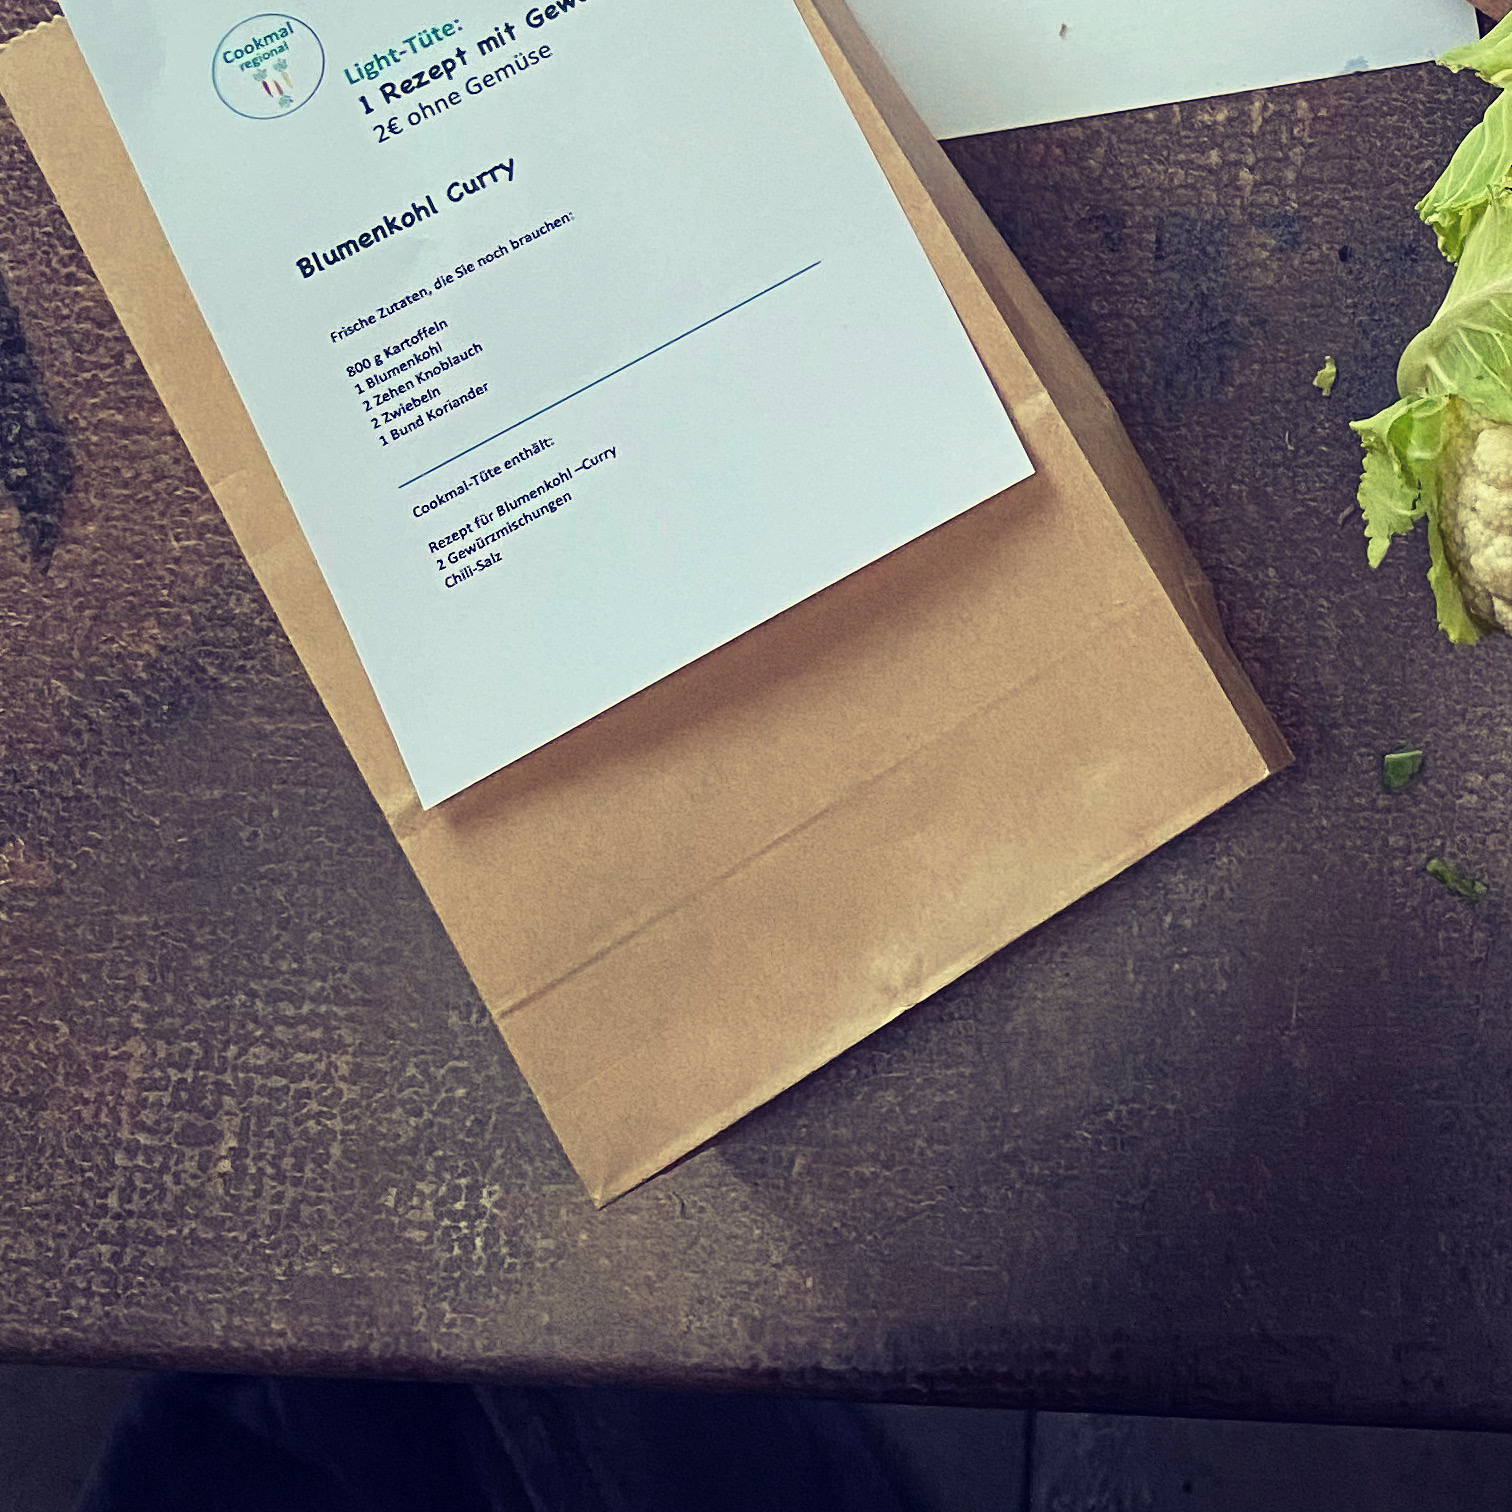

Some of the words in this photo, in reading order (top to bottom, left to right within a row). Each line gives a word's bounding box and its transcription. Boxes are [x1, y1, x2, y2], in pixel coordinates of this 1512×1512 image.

[222, 21, 295, 65] Cookmal
[238, 39, 290, 72] regional
[342, 18, 464, 86] Light-Tüte:
[357, 94, 375, 116] 1
[371, 45, 468, 105] Rezept
[475, 21, 517, 57] mit
[371, 115, 405, 144] 2€
[406, 75, 463, 127] ohne
[464, 44, 554, 96] Gemüse
[294, 193, 440, 280] Blumenkohl
[445, 156, 515, 204] Curry
[329, 314, 378, 344] Frische
[374, 287, 433, 320] Zutaten,
[432, 273, 455, 291] die
[453, 262, 476, 280] Sie
[475, 244, 510, 268] noch
[507, 210, 574, 251] brauchen:
[345, 357, 372, 378] 800
[373, 353, 385, 368] g
[381, 319, 449, 360] Kartoffeln
[353, 382, 366, 396] 1
[364, 340, 443, 390] Blumenkohl
[361, 399, 374, 413] 2
[371, 379, 416, 407] Zehen
[413, 342, 484, 385] Knoblauch
[369, 416, 383, 430] 2
[379, 387, 442, 425] Zwiebeln
[378, 434, 390, 447] 1
[388, 413, 426, 442] Bund
[424, 381, 489, 422] Koriander
[411, 464, 503, 519] Cookmal-Tüte
[502, 436, 556, 471] enthält:
[427, 522, 475, 554] Rezept
[472, 510, 495, 530] für
[494, 466, 574, 518] Blumenkohl
[435, 557, 448, 572] 2
[446, 491, 573, 565] Gewürzmischungen
[443, 551, 504, 589] Chili-Salz
